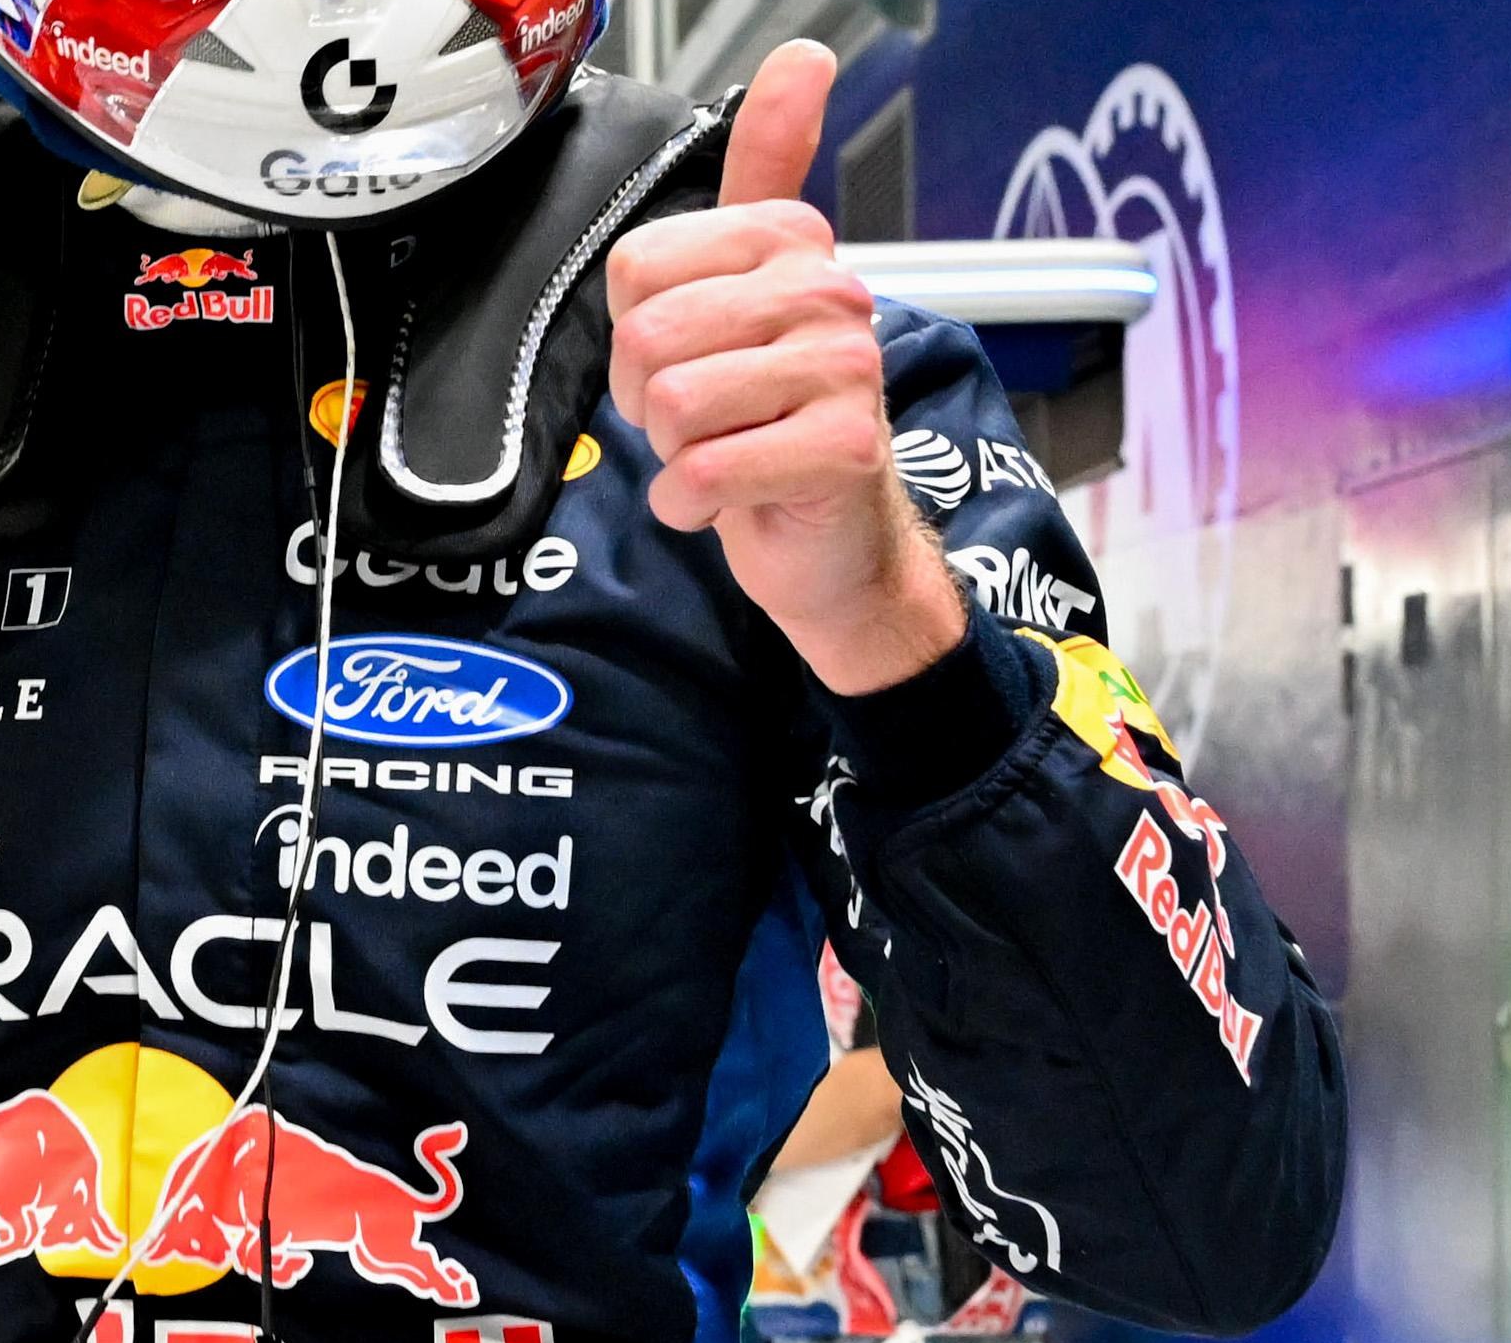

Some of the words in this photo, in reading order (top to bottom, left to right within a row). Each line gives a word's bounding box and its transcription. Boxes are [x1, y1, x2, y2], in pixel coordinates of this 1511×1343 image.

[51, 20, 150, 82] indeed
[124, 287, 199, 331] Red
[199, 285, 274, 325] Bull
[322, 647, 509, 730] Ford
[260, 756, 573, 798] RACING
[256, 805, 572, 910] indeed
[1114, 808, 1210, 981] Red
[1190, 924, 1263, 1088] Bul
